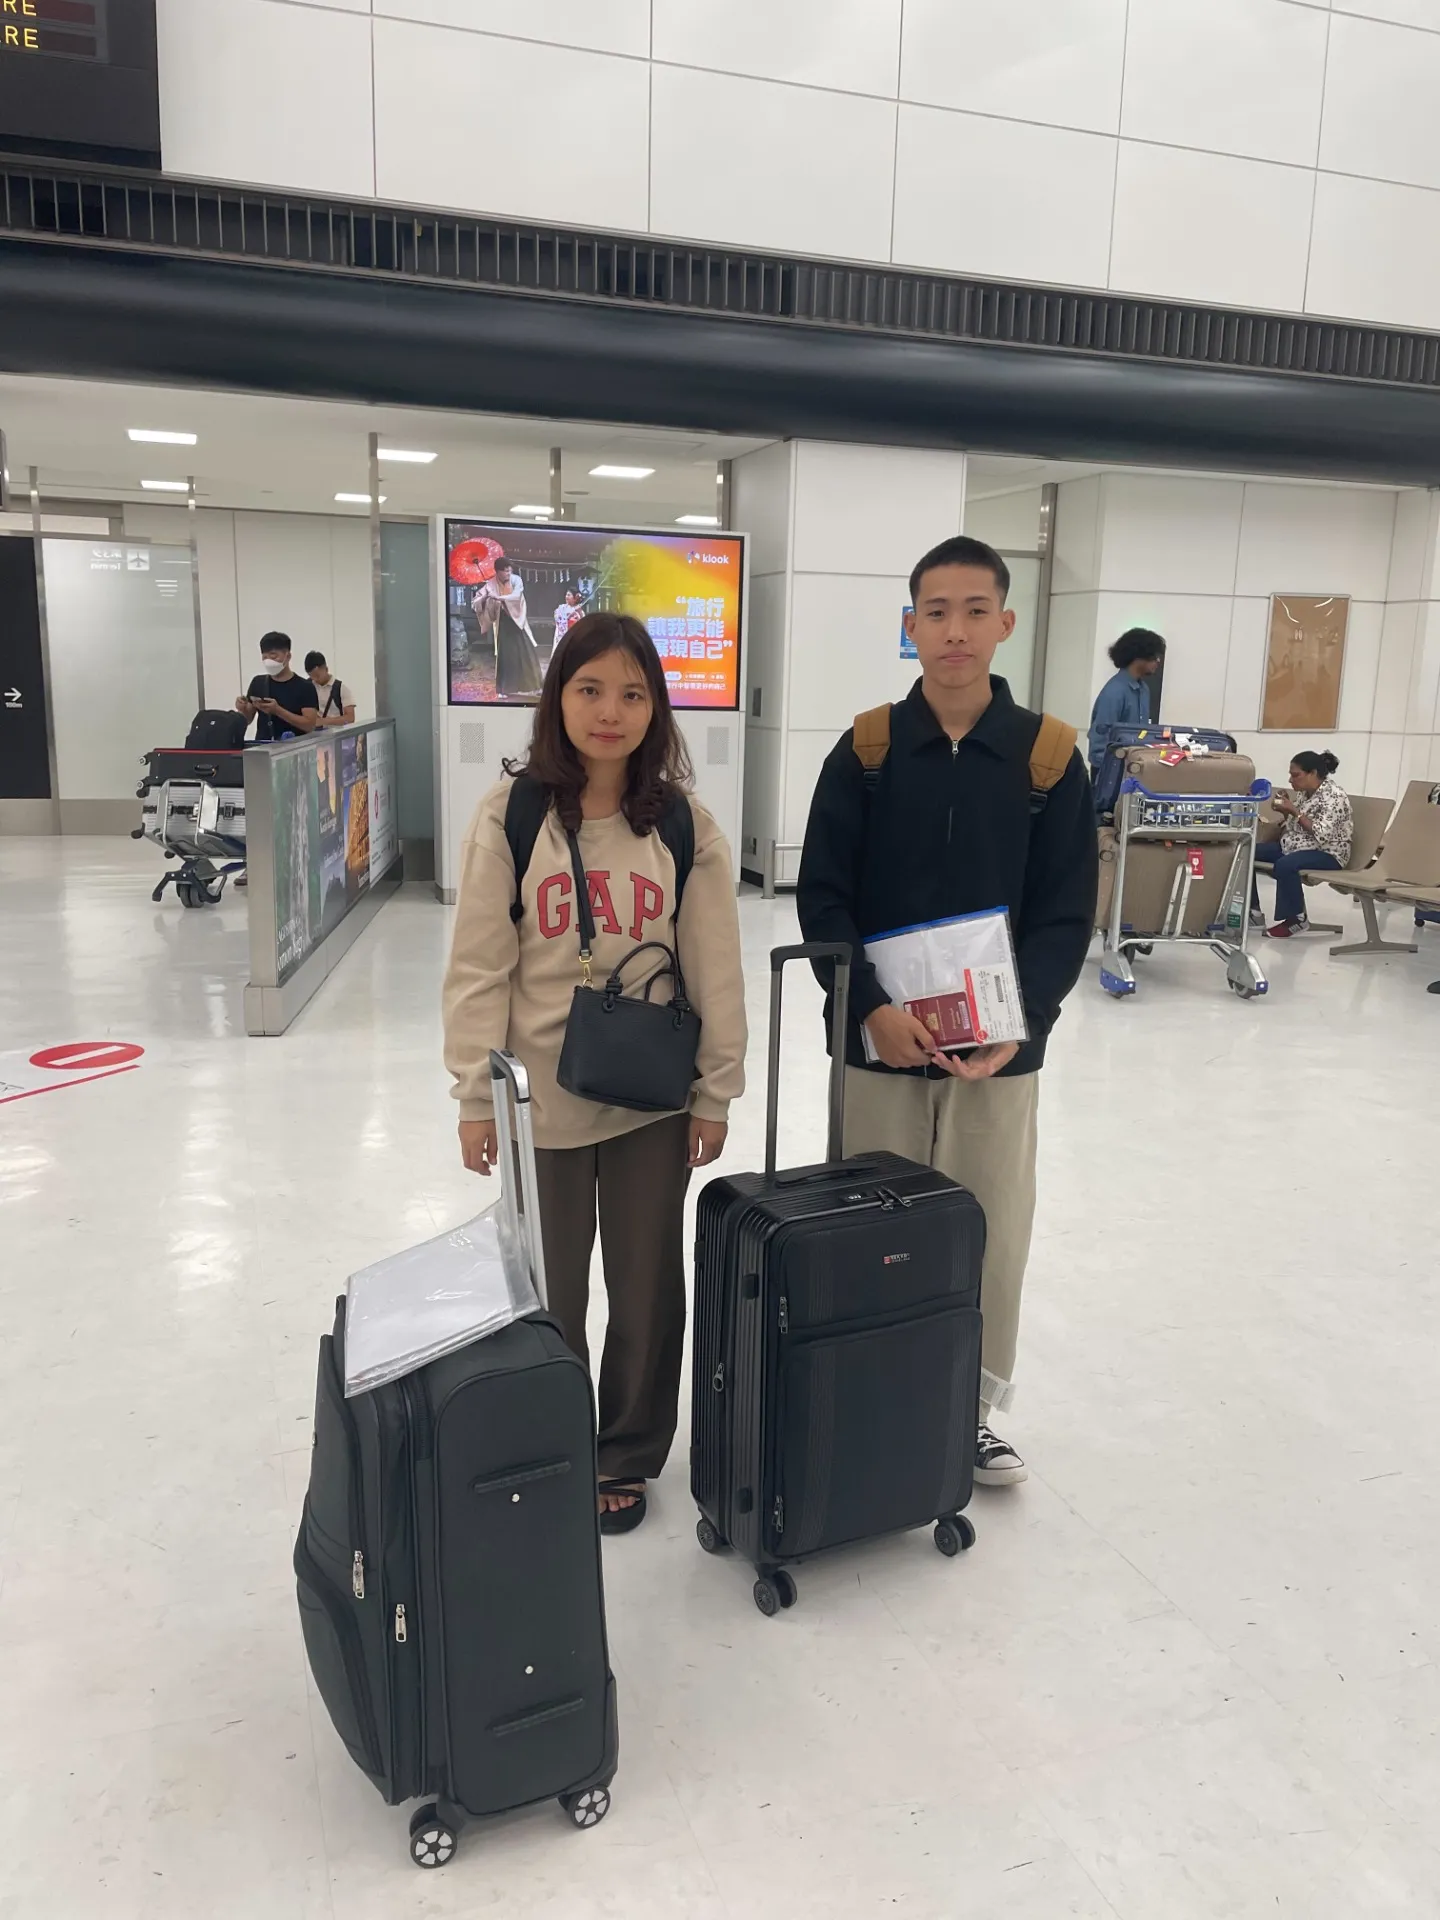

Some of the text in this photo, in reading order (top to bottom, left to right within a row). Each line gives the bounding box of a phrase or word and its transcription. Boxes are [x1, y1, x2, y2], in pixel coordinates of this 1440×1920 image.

[0, 25, 39, 49] RE
[702, 554, 729, 564] klook
[537, 871, 664, 942] GAP
